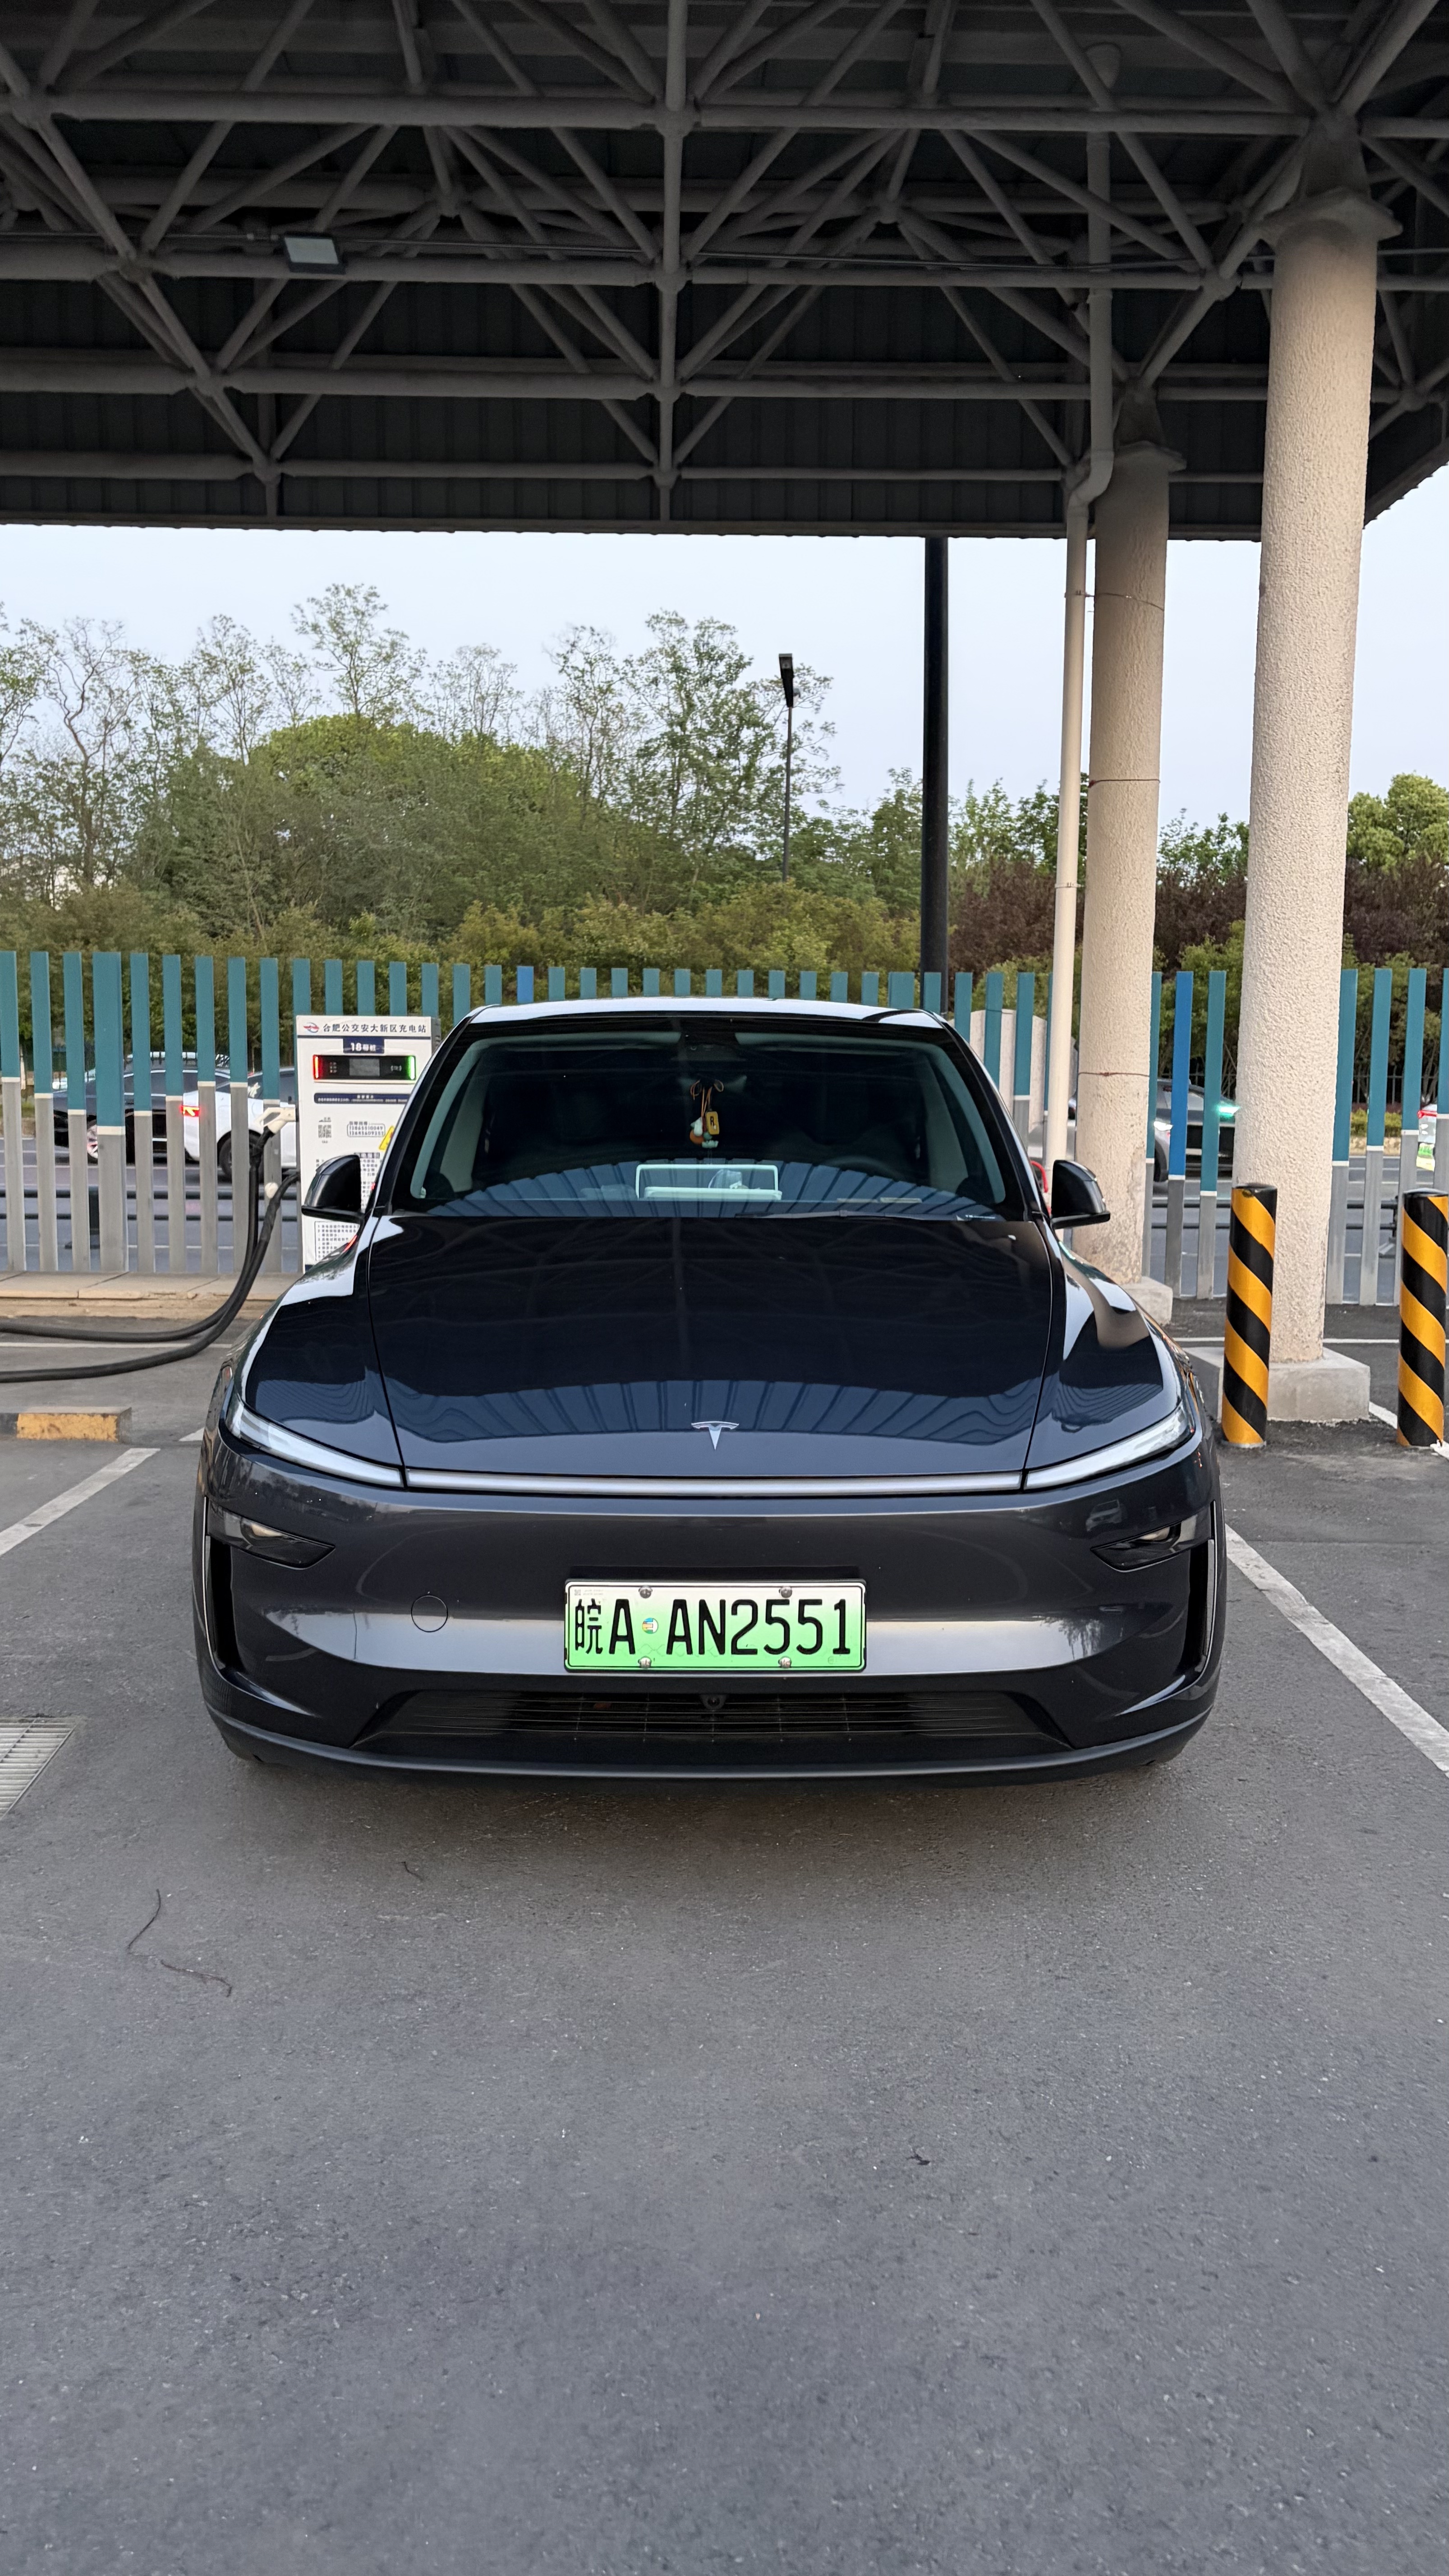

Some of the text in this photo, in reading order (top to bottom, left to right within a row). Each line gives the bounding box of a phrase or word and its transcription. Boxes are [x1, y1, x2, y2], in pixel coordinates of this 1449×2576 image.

[323, 1023, 426, 1033] 合肥公交安大新区充电站
[575, 1598, 850, 1655] 皖A AN2551
